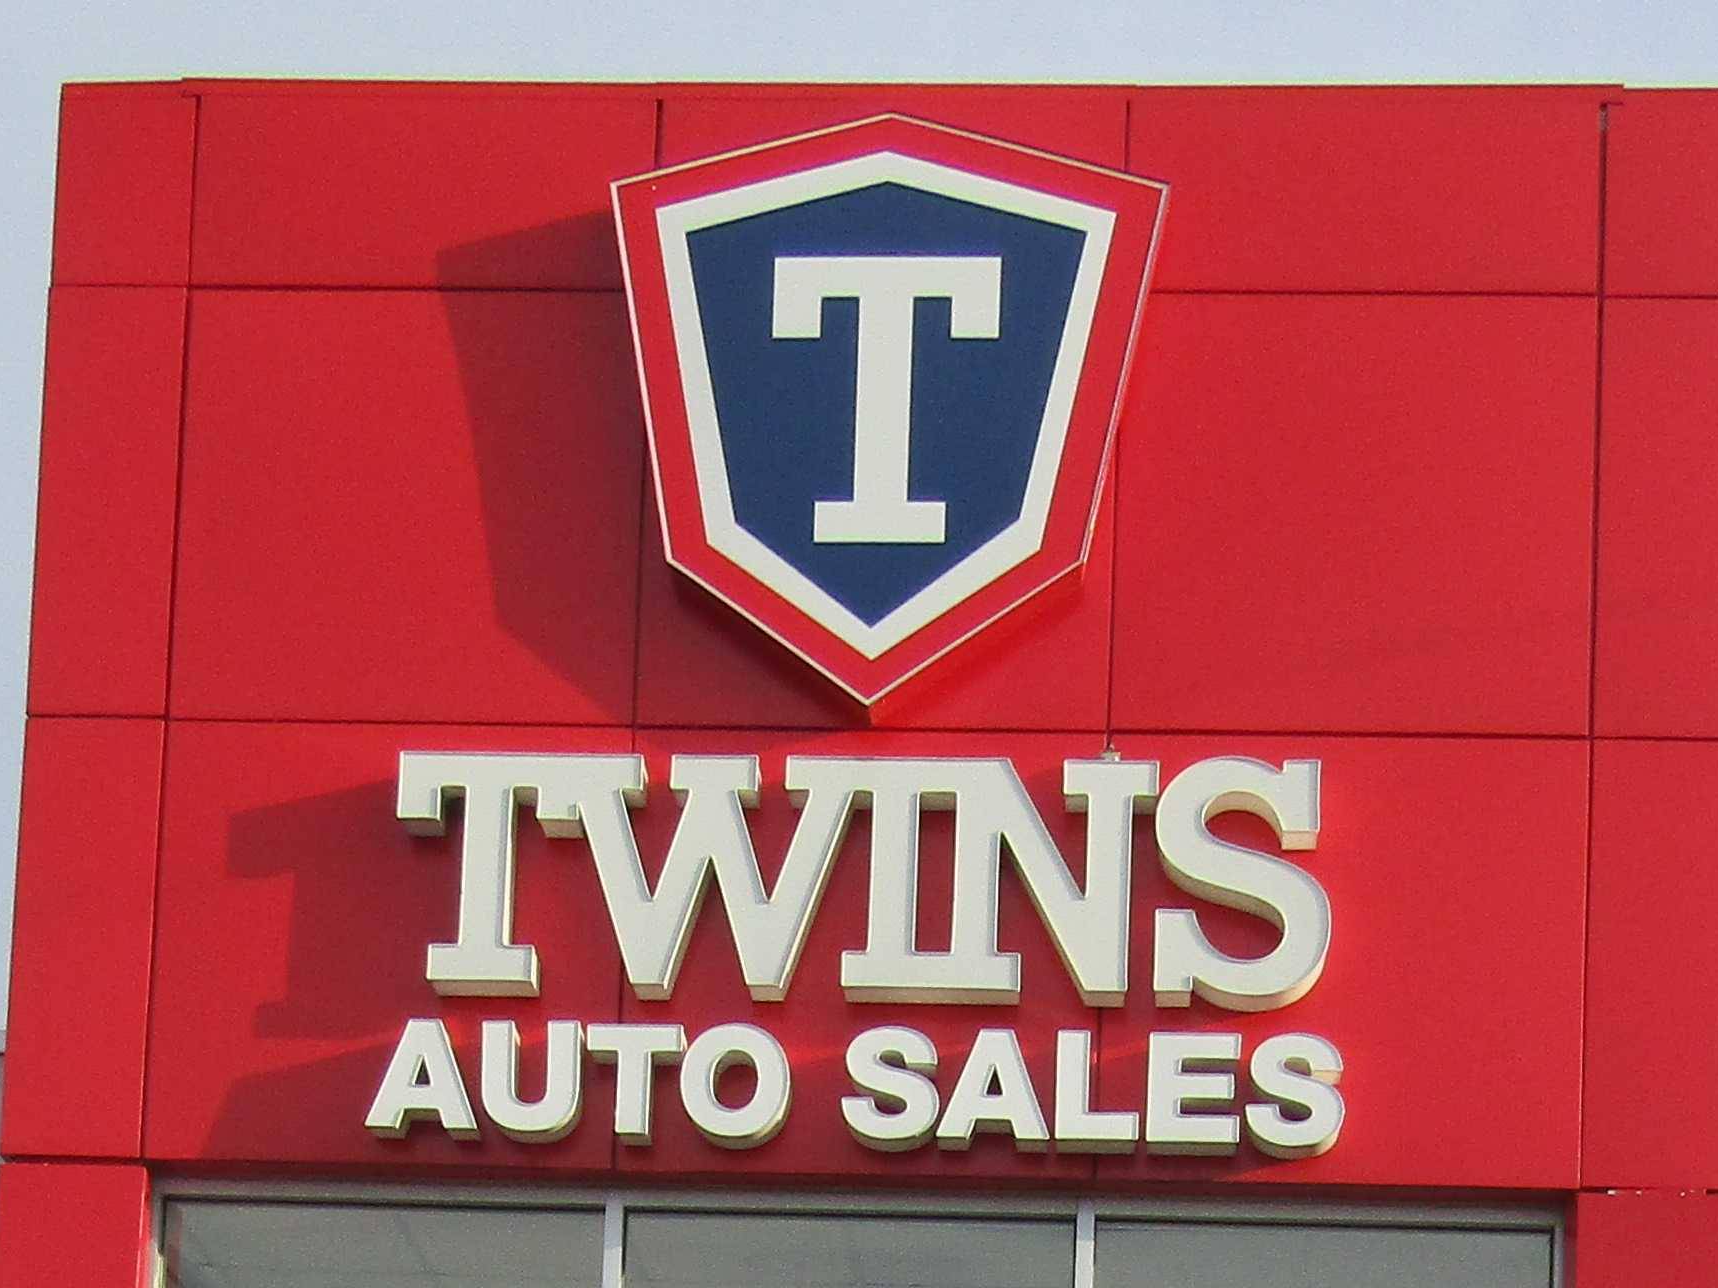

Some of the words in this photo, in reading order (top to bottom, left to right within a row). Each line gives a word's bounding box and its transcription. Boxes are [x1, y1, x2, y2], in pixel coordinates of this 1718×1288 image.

[771, 254, 1003, 544] T
[395, 750, 1332, 1013] TWINS
[364, 1017, 793, 1149] AUTO
[840, 1025, 1345, 1158] SALES
